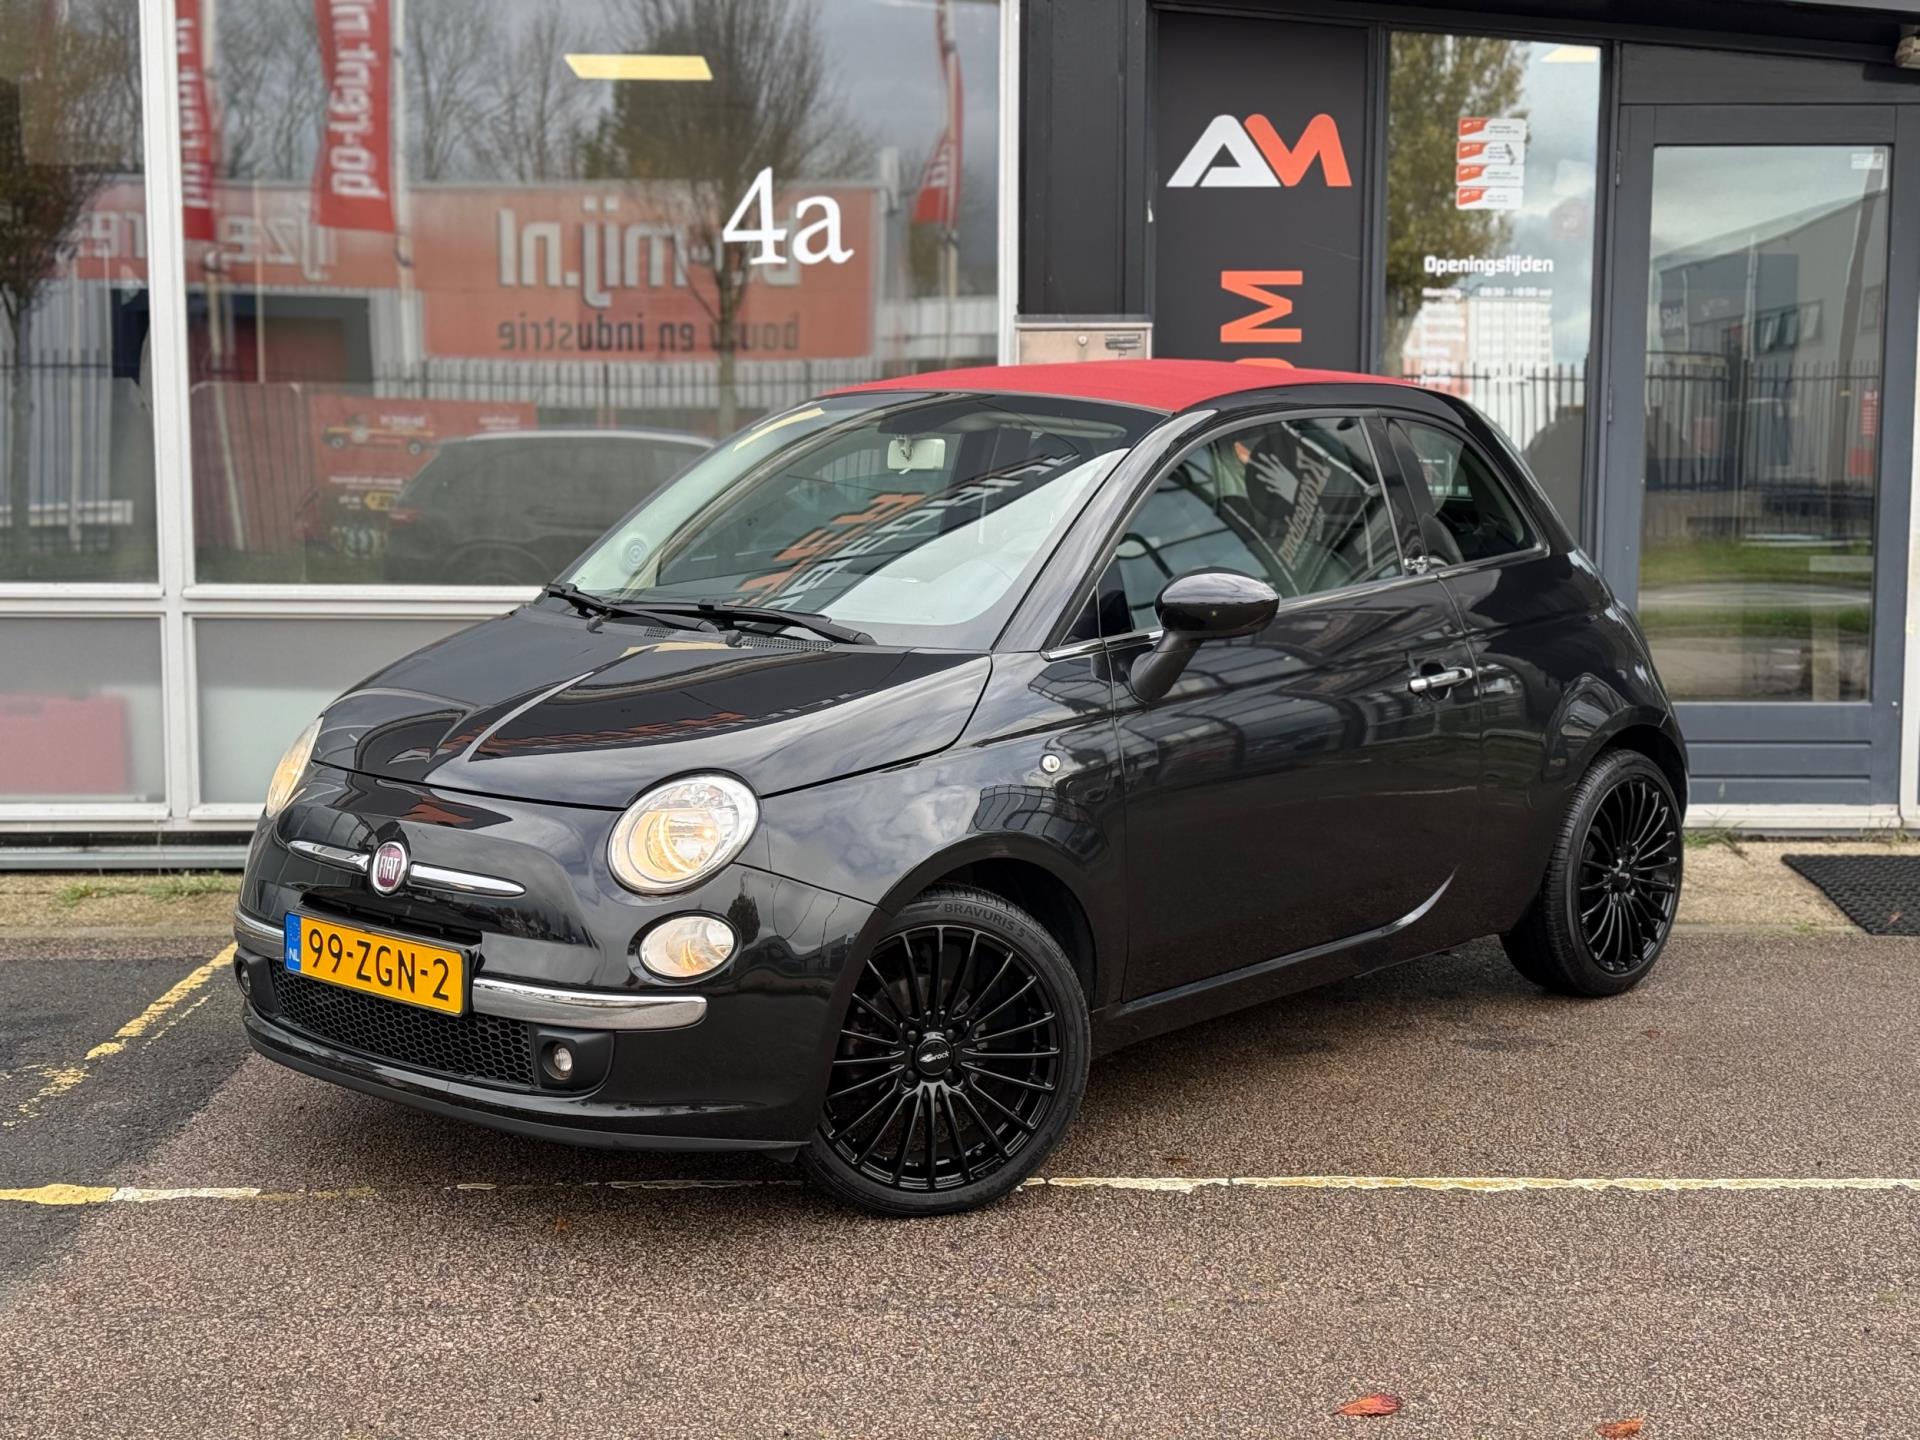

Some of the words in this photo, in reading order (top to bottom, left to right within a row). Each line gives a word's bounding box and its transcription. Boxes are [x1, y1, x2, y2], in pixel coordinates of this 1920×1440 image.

[1166, 113, 1352, 187] AM
[723, 166, 854, 264] 4a
[1424, 255, 1554, 277] Openingstijden
[378, 856, 400, 880] FIAT
[944, 903, 1016, 931] BRAVURIS
[288, 946, 300, 962] NL
[308, 928, 450, 1001] 99-ZGN-2
